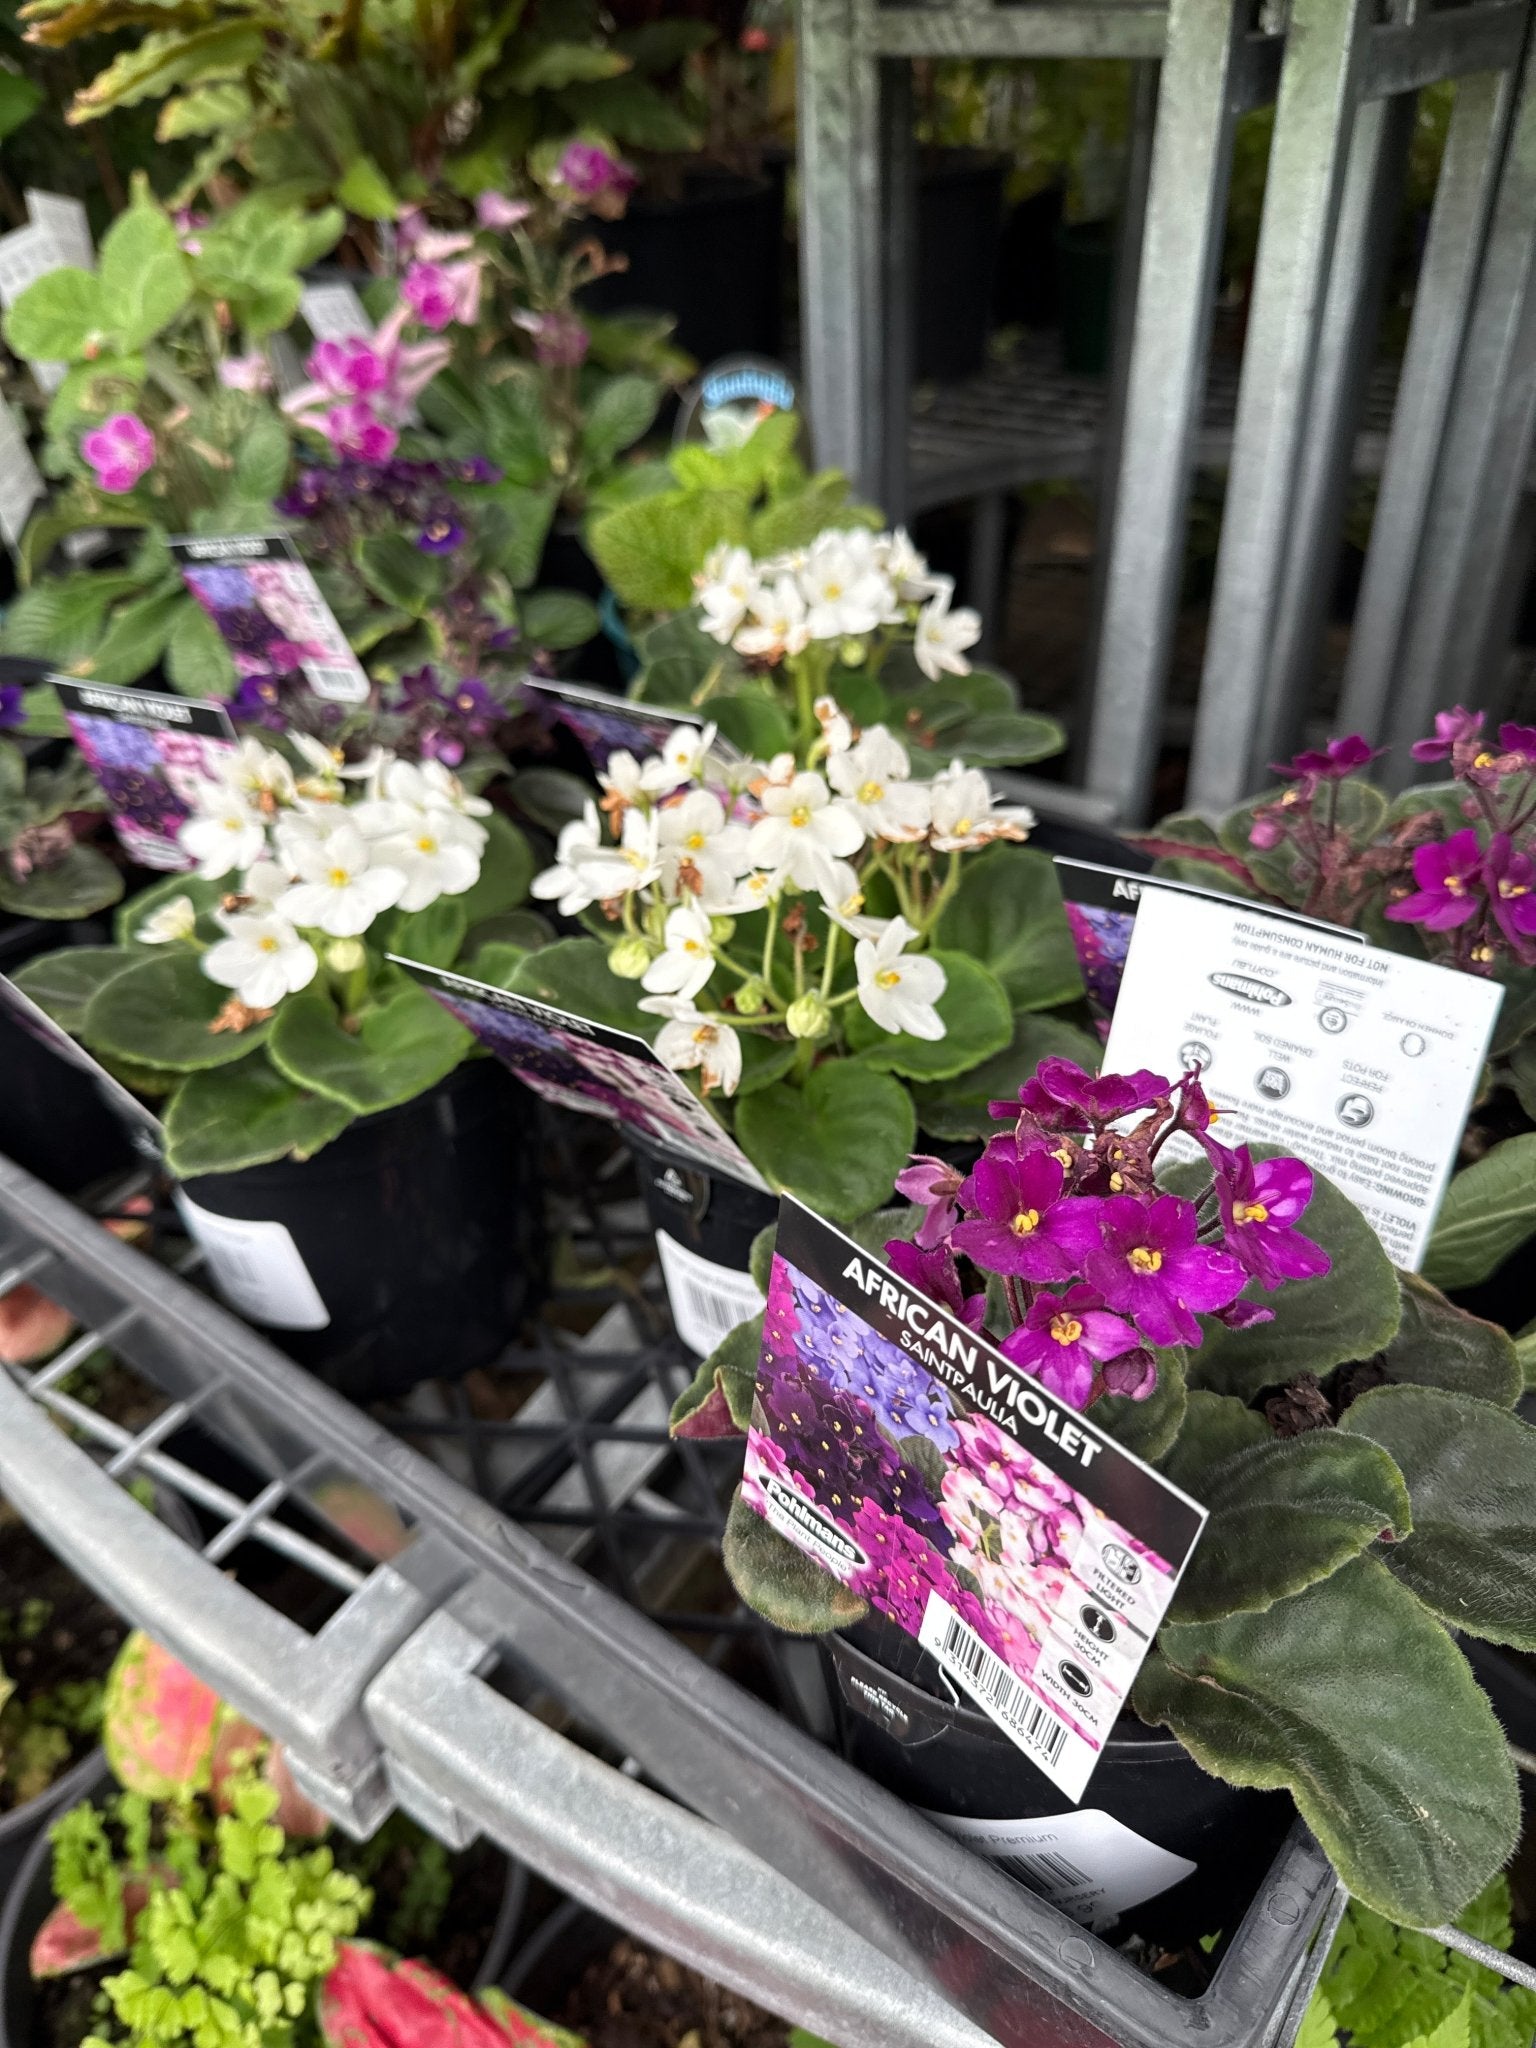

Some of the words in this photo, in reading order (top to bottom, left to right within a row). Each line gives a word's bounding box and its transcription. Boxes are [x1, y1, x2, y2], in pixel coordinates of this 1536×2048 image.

[1233, 921, 1303, 949] CONSUMPTION
[1304, 941, 1342, 960] HUMAN
[1343, 952, 1365, 966] FOR
[1366, 958, 1388, 973] NOT
[1212, 973, 1283, 1005] Pohlmans
[1341, 1059, 1367, 1075] POTS
[1368, 1067, 1389, 1081] FOR
[1339, 1072, 1383, 1093] PERFECT
[1380, 1211, 1417, 1231] VIOLET
[842, 1257, 978, 1373] AFRICAN
[985, 1360, 1102, 1469] VIOLET
[899, 1329, 1020, 1436] SAINTPAULIA
[767, 1481, 856, 1561] Pohlmans
[786, 1517, 810, 1542] Plant
[1093, 1567, 1135, 1606] FILTERED
[1095, 1582, 1125, 1610] LIGHT
[1073, 1627, 1108, 1661] HEIGHT
[1073, 1639, 1101, 1667] 30CM
[933, 1636, 941, 1649] 9
[947, 1651, 994, 1705] 314372
[1000, 1708, 1049, 1762] 686474
[1041, 1670, 1070, 1700] WIDTH
[1071, 1699, 1099, 1726] 30CM
[988, 1833, 1058, 1845] Premium
